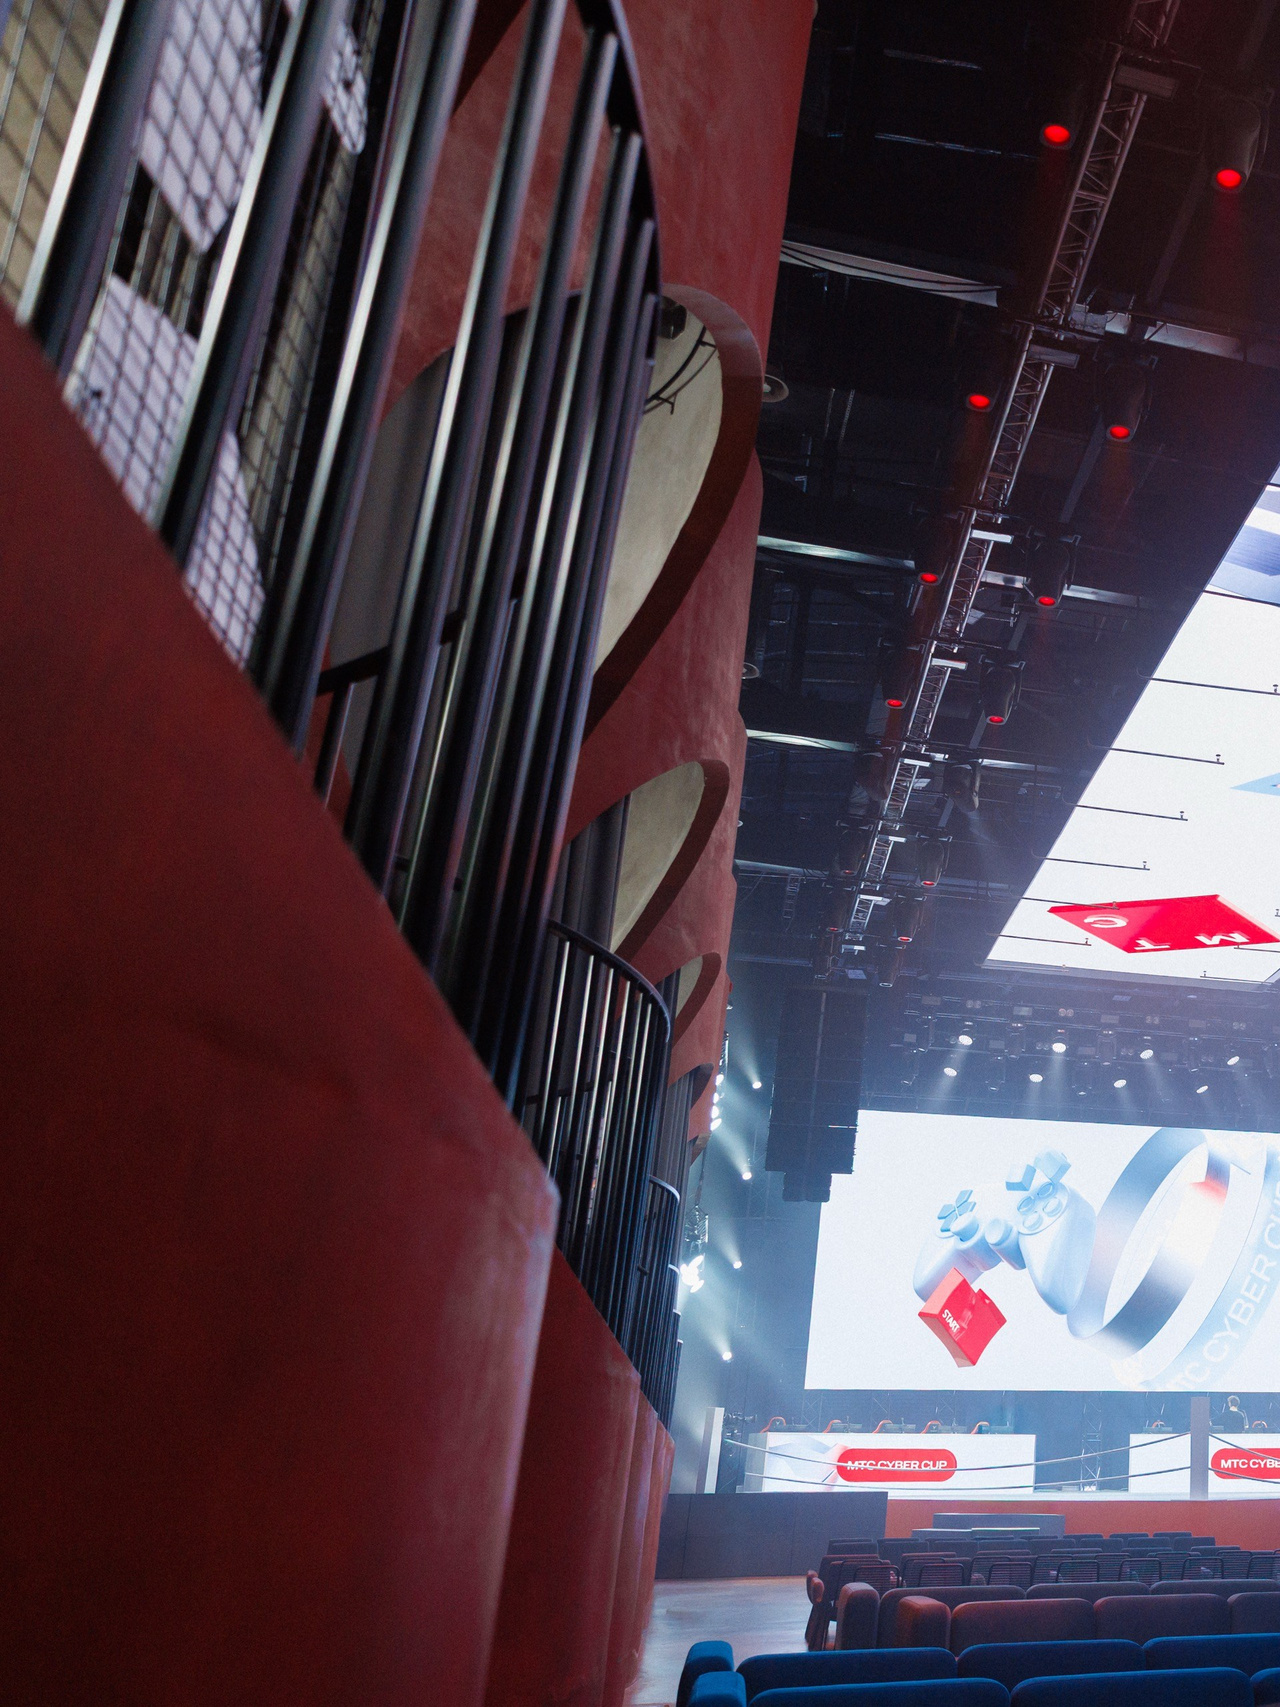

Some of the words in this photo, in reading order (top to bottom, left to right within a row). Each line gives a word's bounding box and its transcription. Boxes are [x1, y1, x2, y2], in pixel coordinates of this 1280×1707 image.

[1202, 1254, 1277, 1363] CYBER
[942, 1309, 960, 1332] START
[847, 1460, 876, 1471] MTC
[877, 1460, 920, 1471] CYBER
[921, 1460, 948, 1471] CUP
[1220, 1459, 1248, 1469] MTC
